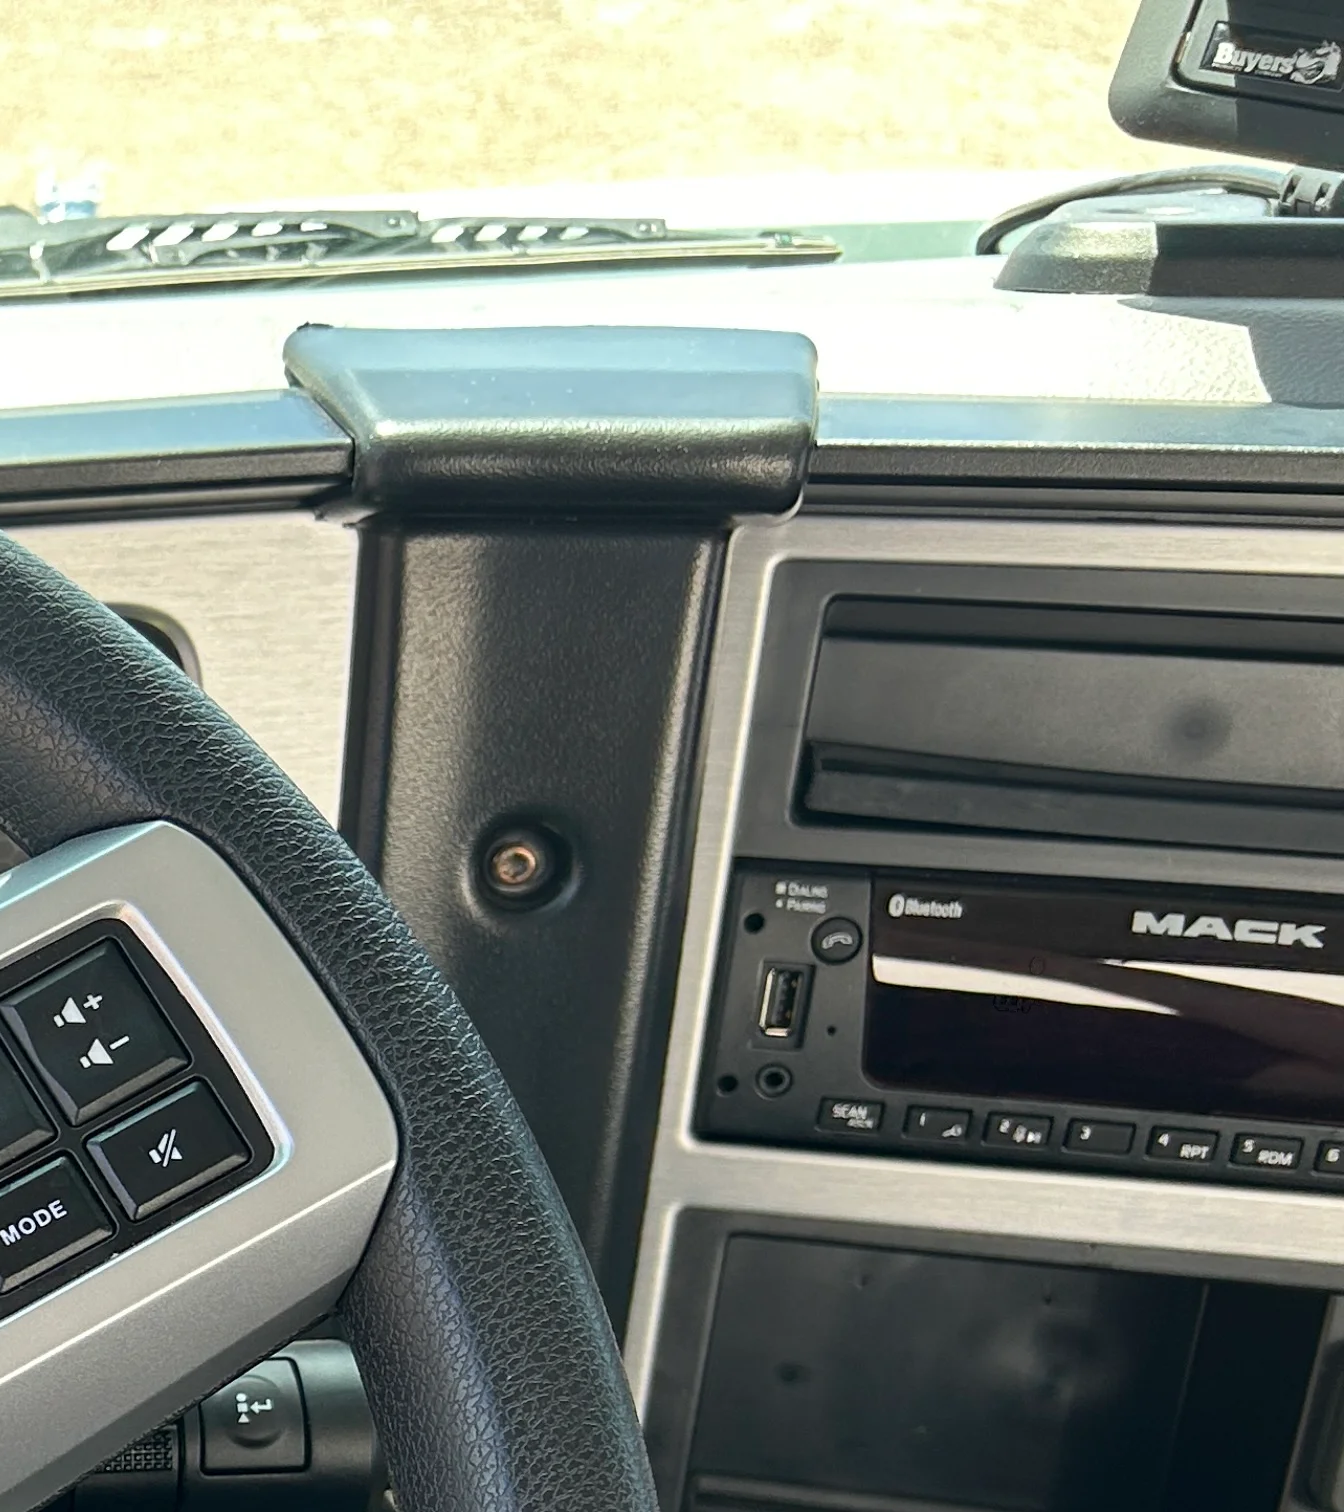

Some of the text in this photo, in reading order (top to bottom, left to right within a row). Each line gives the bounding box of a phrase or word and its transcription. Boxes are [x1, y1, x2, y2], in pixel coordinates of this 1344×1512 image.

[1212, 42, 1295, 74] Buyers
[904, 897, 963, 919] Bluetooth
[1131, 911, 1326, 949] MACK
[1080, 1126, 1091, 1140] 3
[1157, 1133, 1170, 1146] 4
[1179, 1144, 1210, 1160] RPT
[1256, 1149, 1293, 1166] RDM
